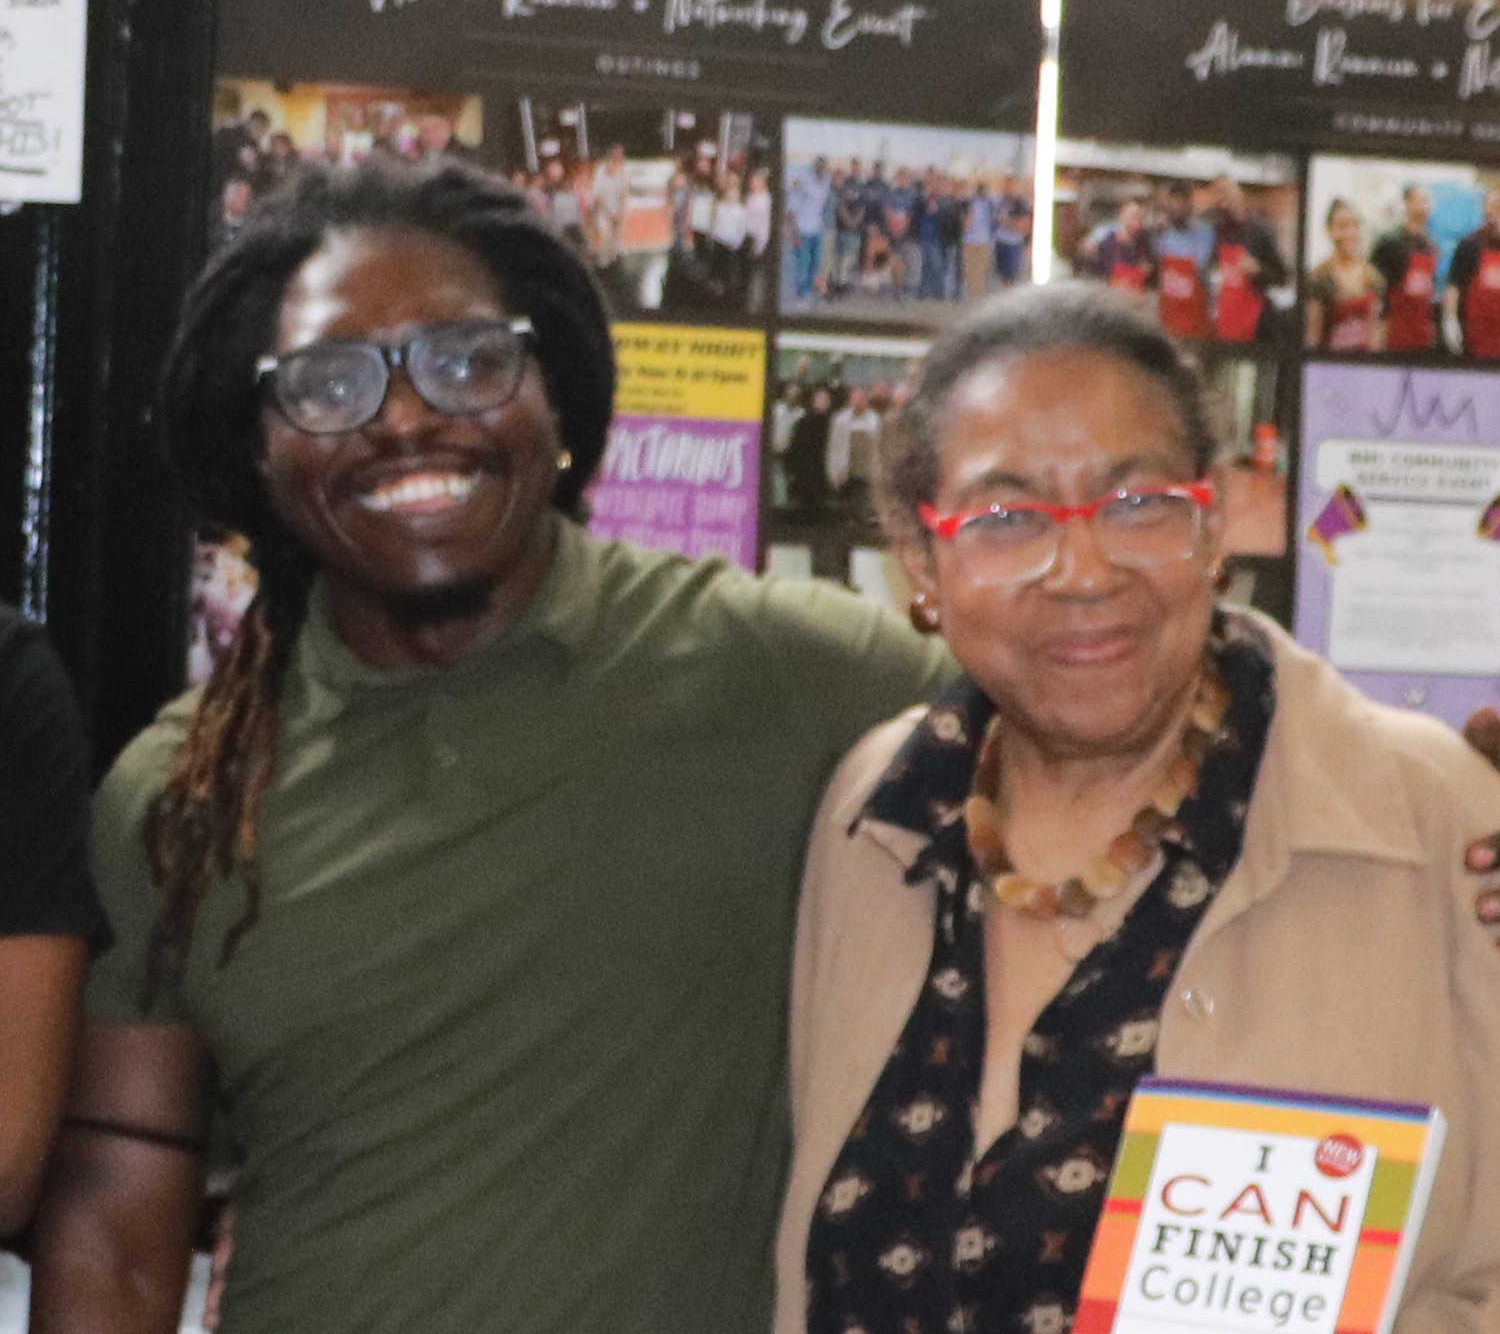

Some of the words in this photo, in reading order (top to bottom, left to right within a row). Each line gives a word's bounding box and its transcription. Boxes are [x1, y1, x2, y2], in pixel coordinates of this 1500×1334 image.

[1254, 1144, 1273, 1172] I
[1159, 1174, 1353, 1233] CAN
[1149, 1223, 1342, 1276] FINISH
[1139, 1264, 1328, 1327] College
